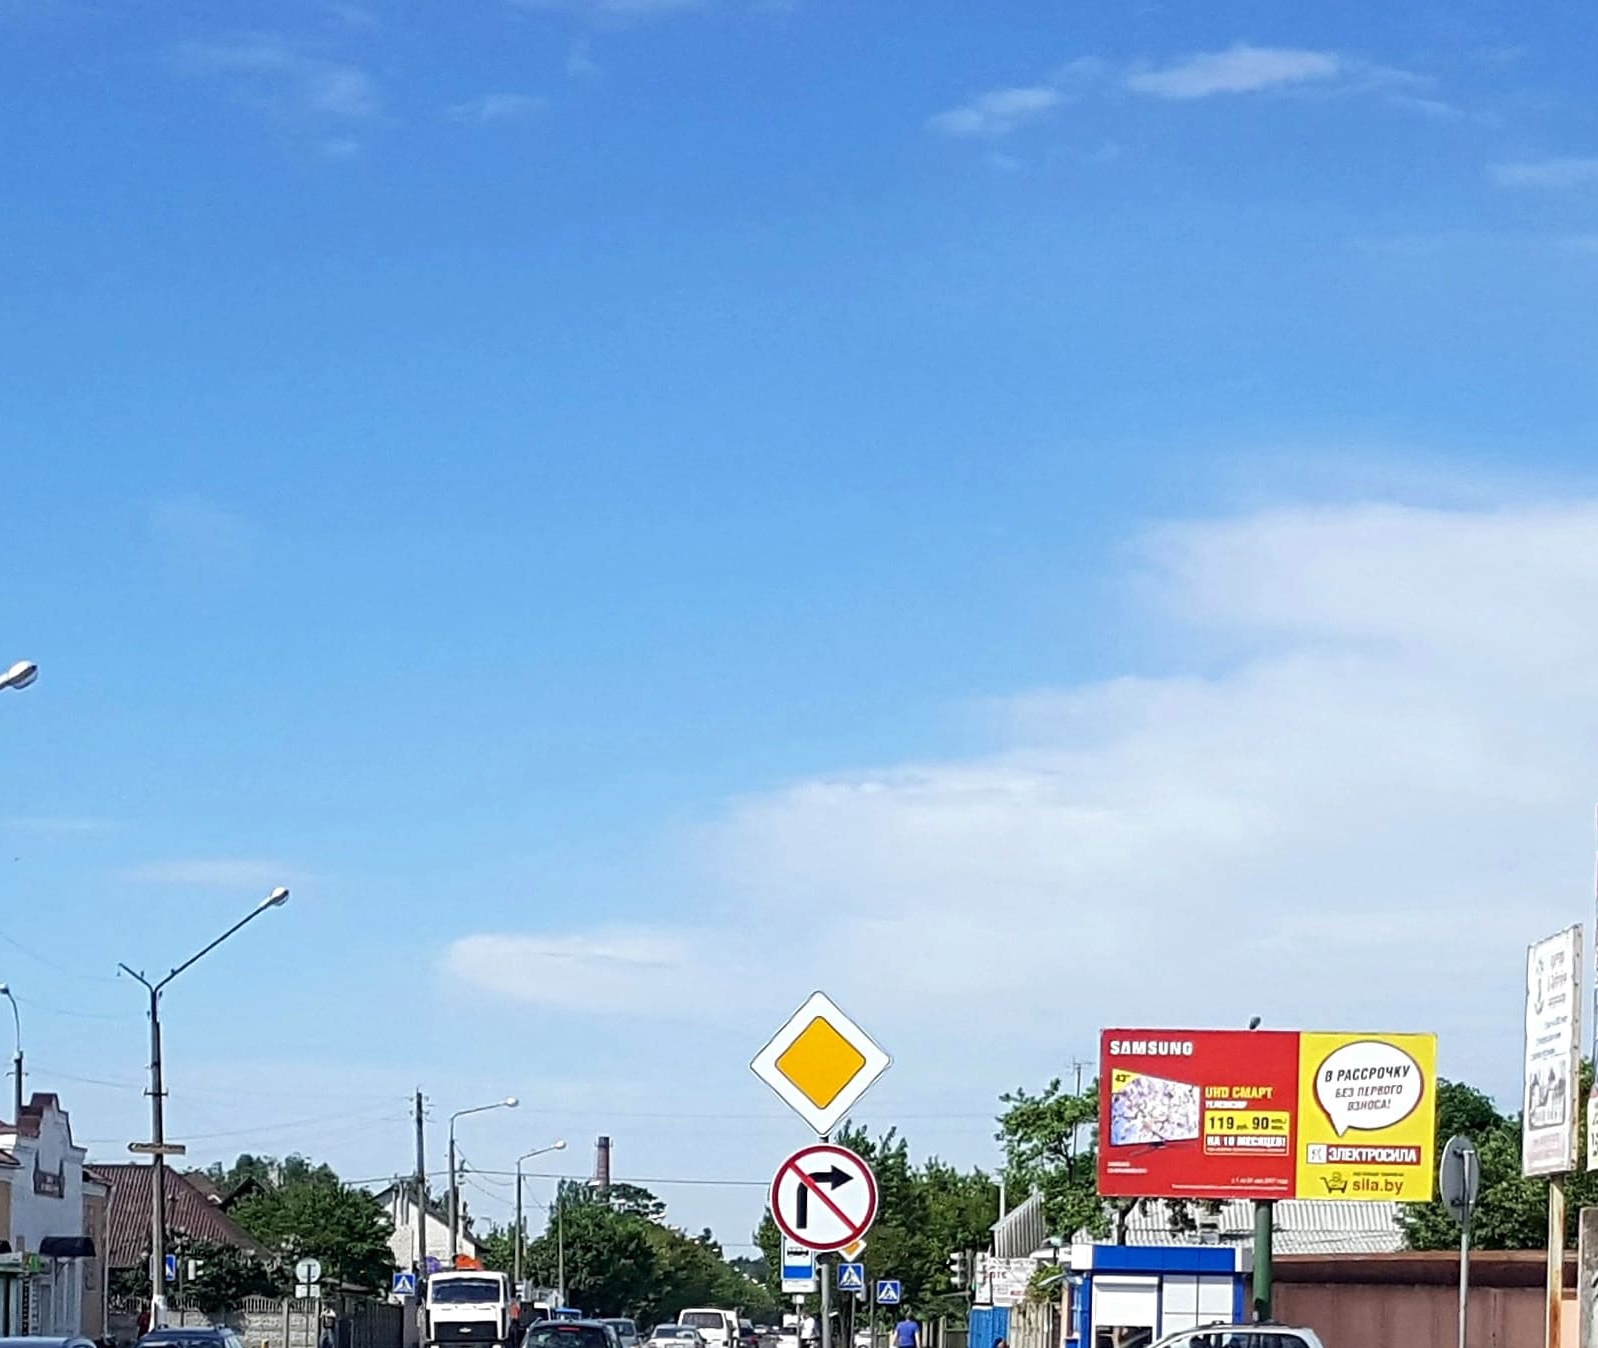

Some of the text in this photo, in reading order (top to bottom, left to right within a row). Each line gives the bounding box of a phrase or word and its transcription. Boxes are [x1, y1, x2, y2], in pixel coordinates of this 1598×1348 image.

[1110, 1040, 1193, 1056] SAMSUNG
[1324, 1065, 1411, 1083] В РАССРОЧКУ
[1205, 1086, 1273, 1099] UHD СМАРТ
[1335, 1084, 1403, 1098] БЕЗ ПЕРВОГО
[1347, 1099, 1392, 1111] ВЗНОСА!
[1209, 1116, 1234, 1130] 119
[1252, 1116, 1269, 1130] 90
[1328, 1147, 1417, 1162] ЭЛЕКТРОСИЛА
[1352, 1178, 1404, 1195] sila.by
